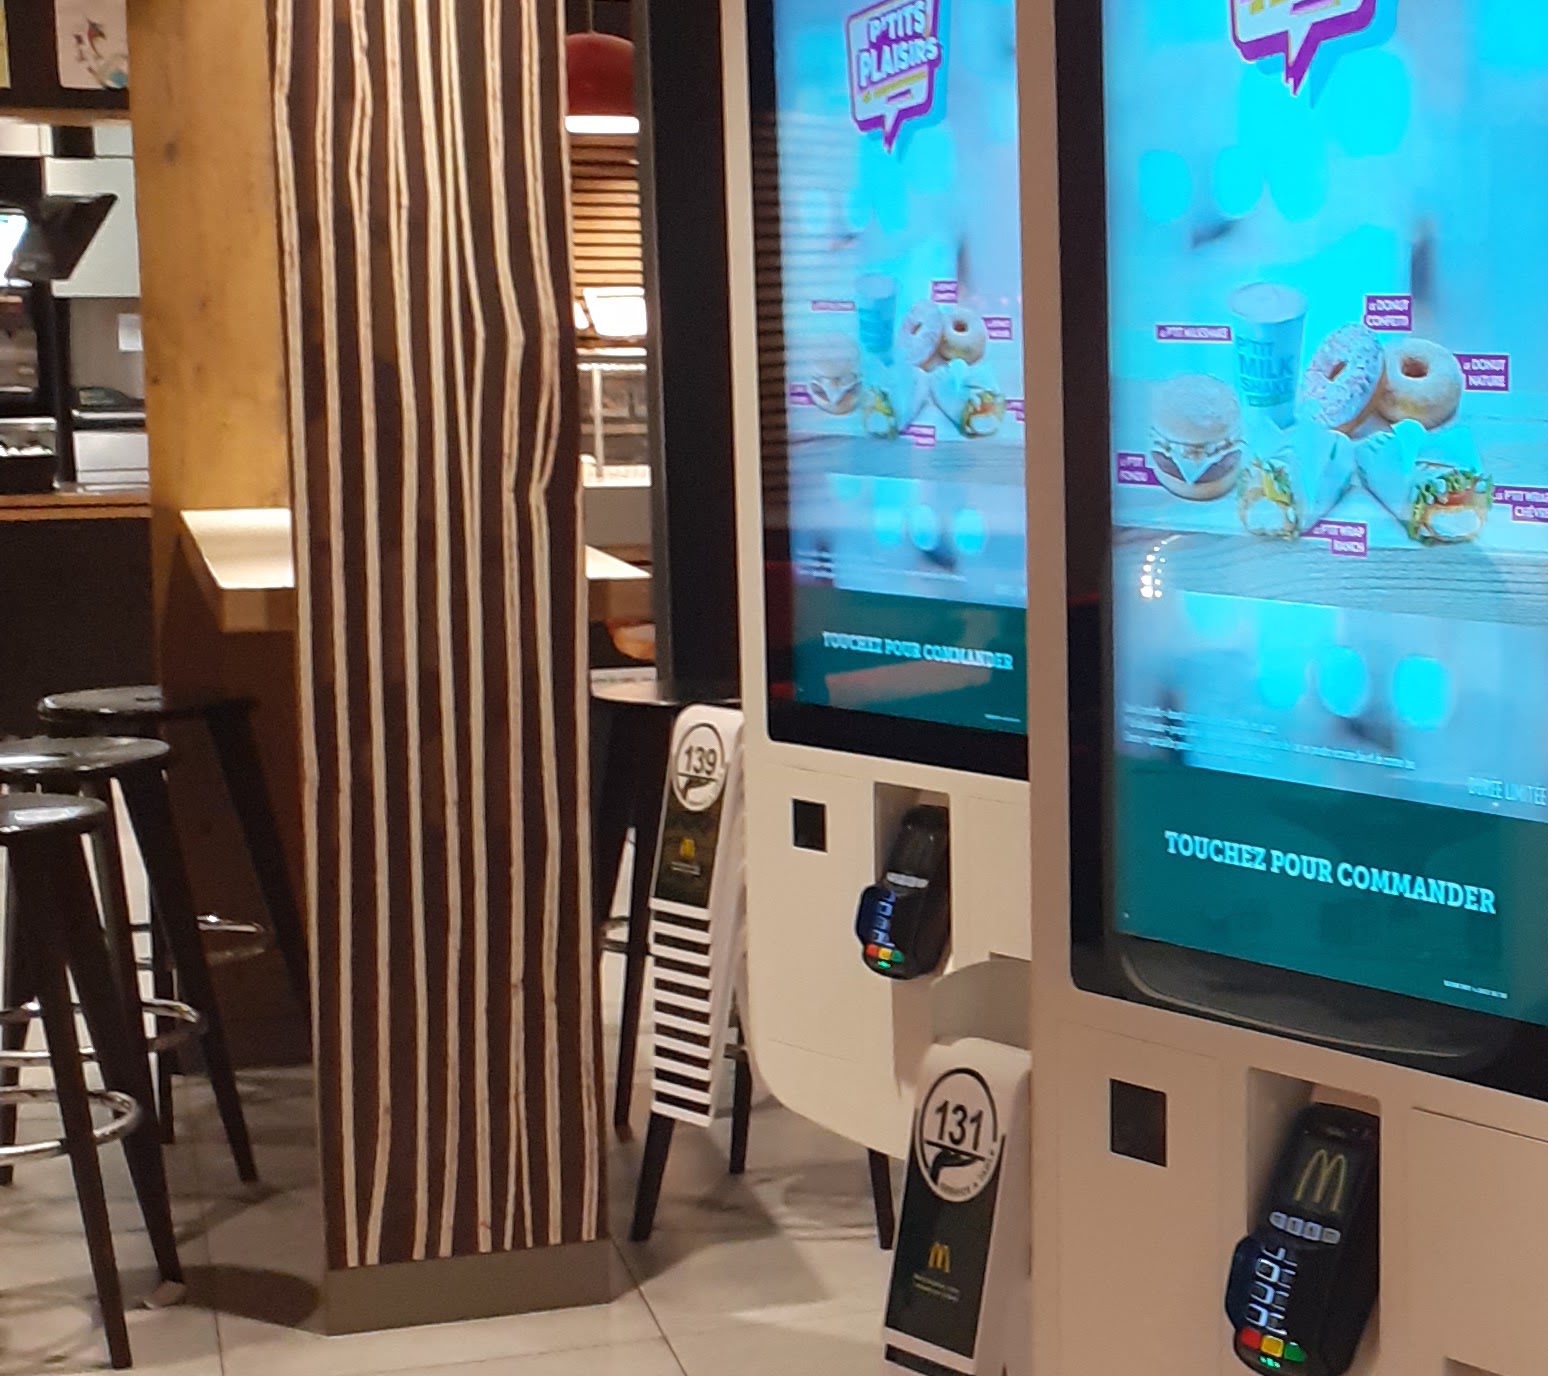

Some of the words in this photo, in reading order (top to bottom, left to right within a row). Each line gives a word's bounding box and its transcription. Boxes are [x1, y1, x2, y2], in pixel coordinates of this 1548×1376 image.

[859, 37, 939, 87] PLAISIRS
[684, 745, 717, 775] 139
[1164, 830, 1267, 871] TOUCHEZ
[1270, 849, 1334, 884] POUR
[1336, 862, 1497, 915] COMMANDER
[935, 1100, 984, 1151] 131
